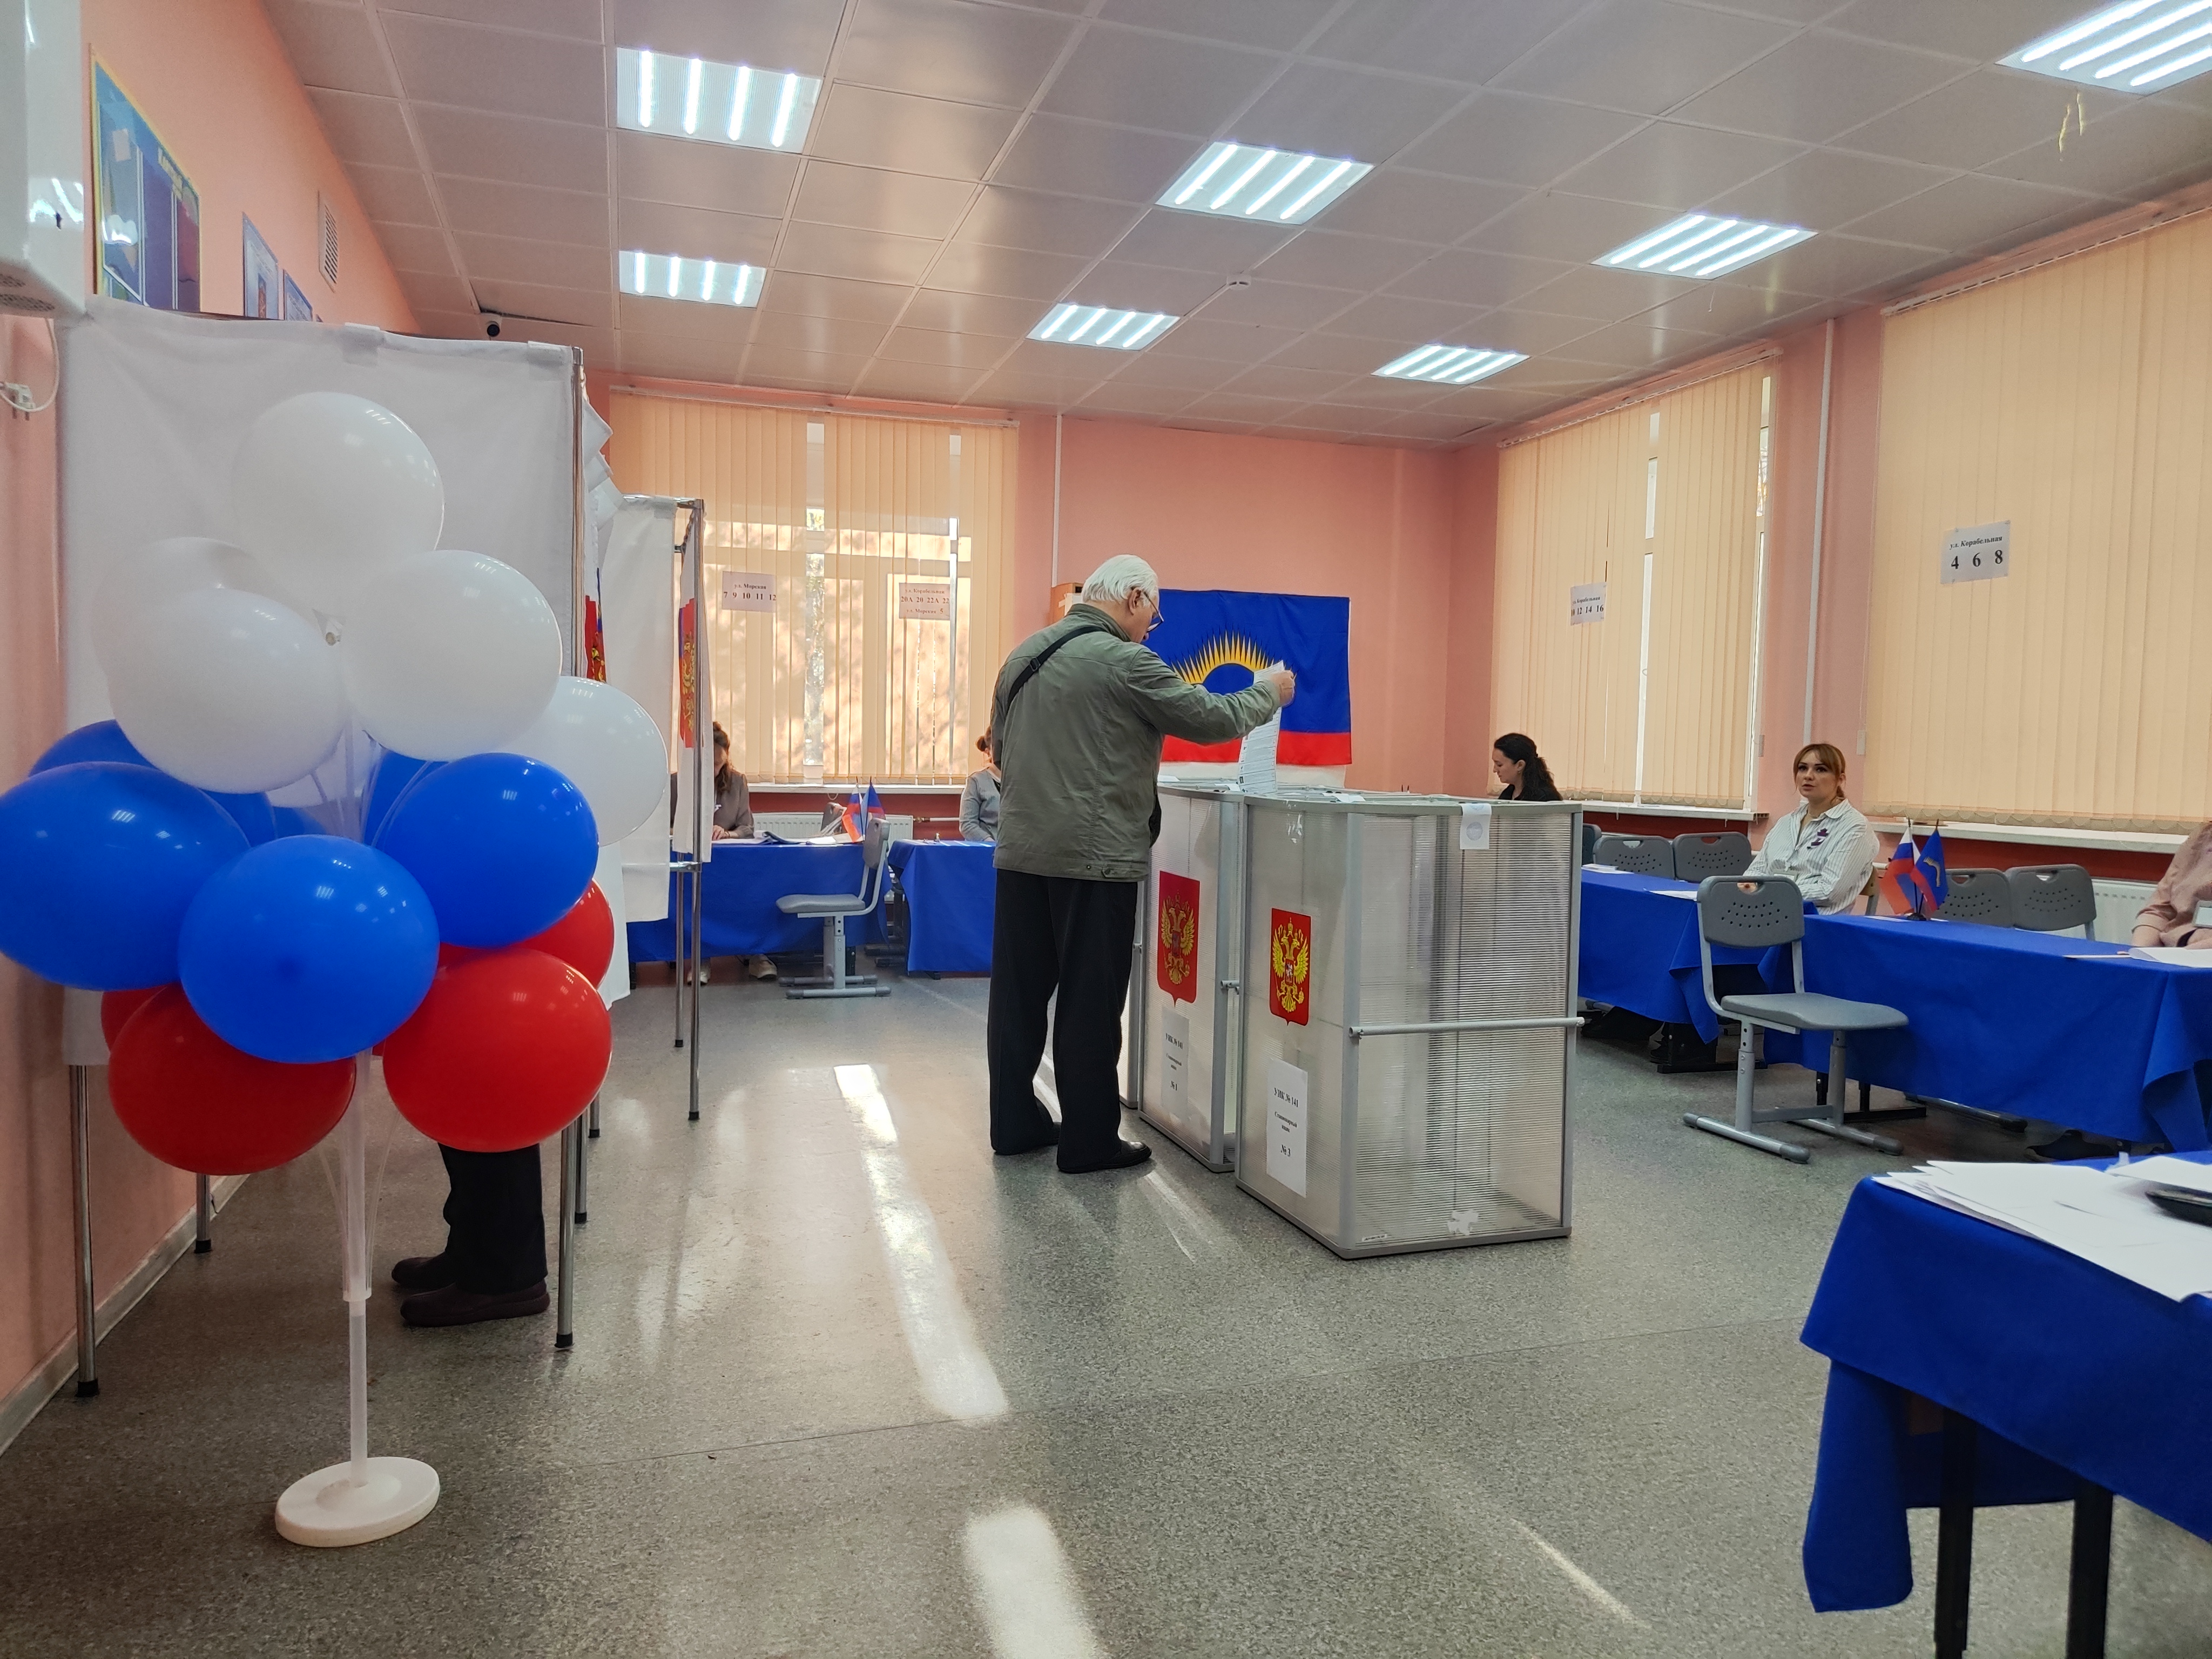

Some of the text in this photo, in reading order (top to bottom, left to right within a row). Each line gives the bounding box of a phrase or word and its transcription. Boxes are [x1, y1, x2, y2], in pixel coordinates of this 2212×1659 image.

[1961, 536, 2002, 547] Корабельная
[1951, 550, 2003, 569] 4 6 8
[1577, 607, 1582, 615] 12
[1586, 605, 1592, 613] 14
[1596, 604, 1604, 612] 16
[1274, 1087, 1285, 1101] УИК
[1285, 1094, 1291, 1103] №
[1280, 1144, 1291, 1157] № 3
